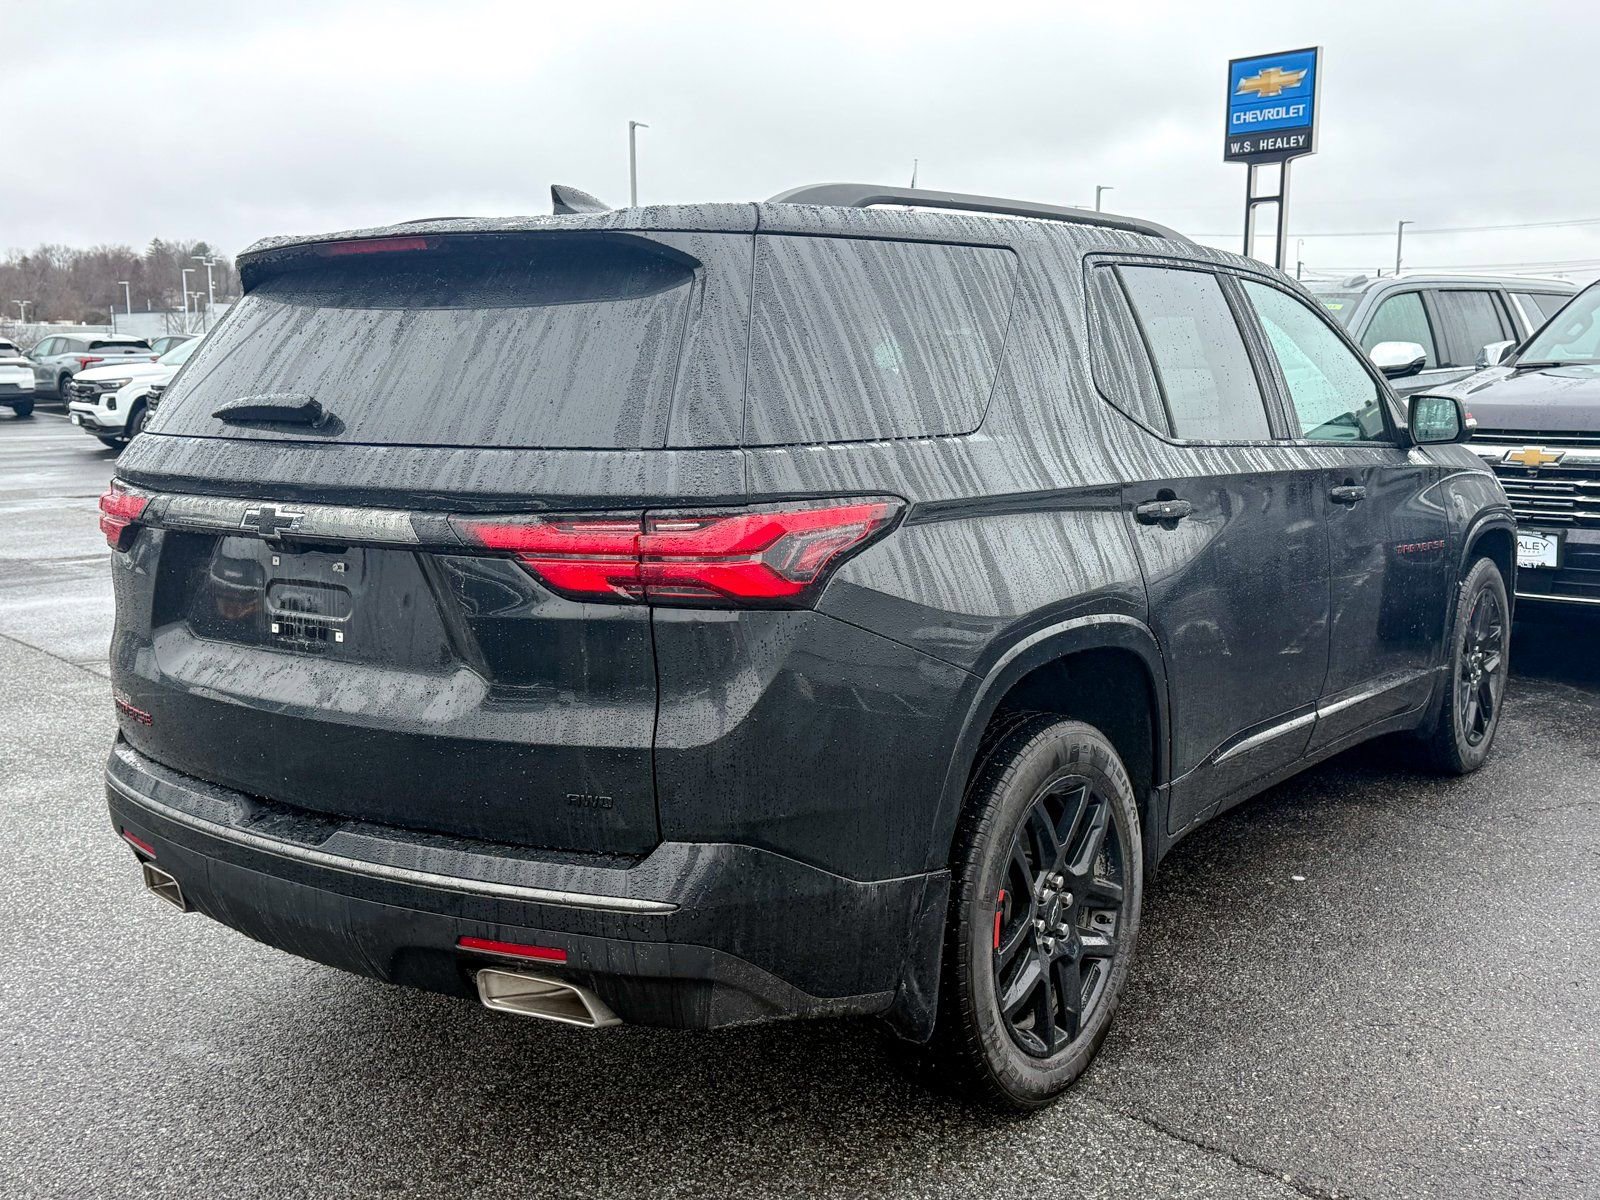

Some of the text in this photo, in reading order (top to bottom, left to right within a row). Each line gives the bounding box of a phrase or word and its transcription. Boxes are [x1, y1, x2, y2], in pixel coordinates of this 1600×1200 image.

[1232, 104, 1306, 125] CHEVROLET
[1230, 134, 1306, 154] W.S. HEALEY
[1517, 541, 1549, 551] ALEY
